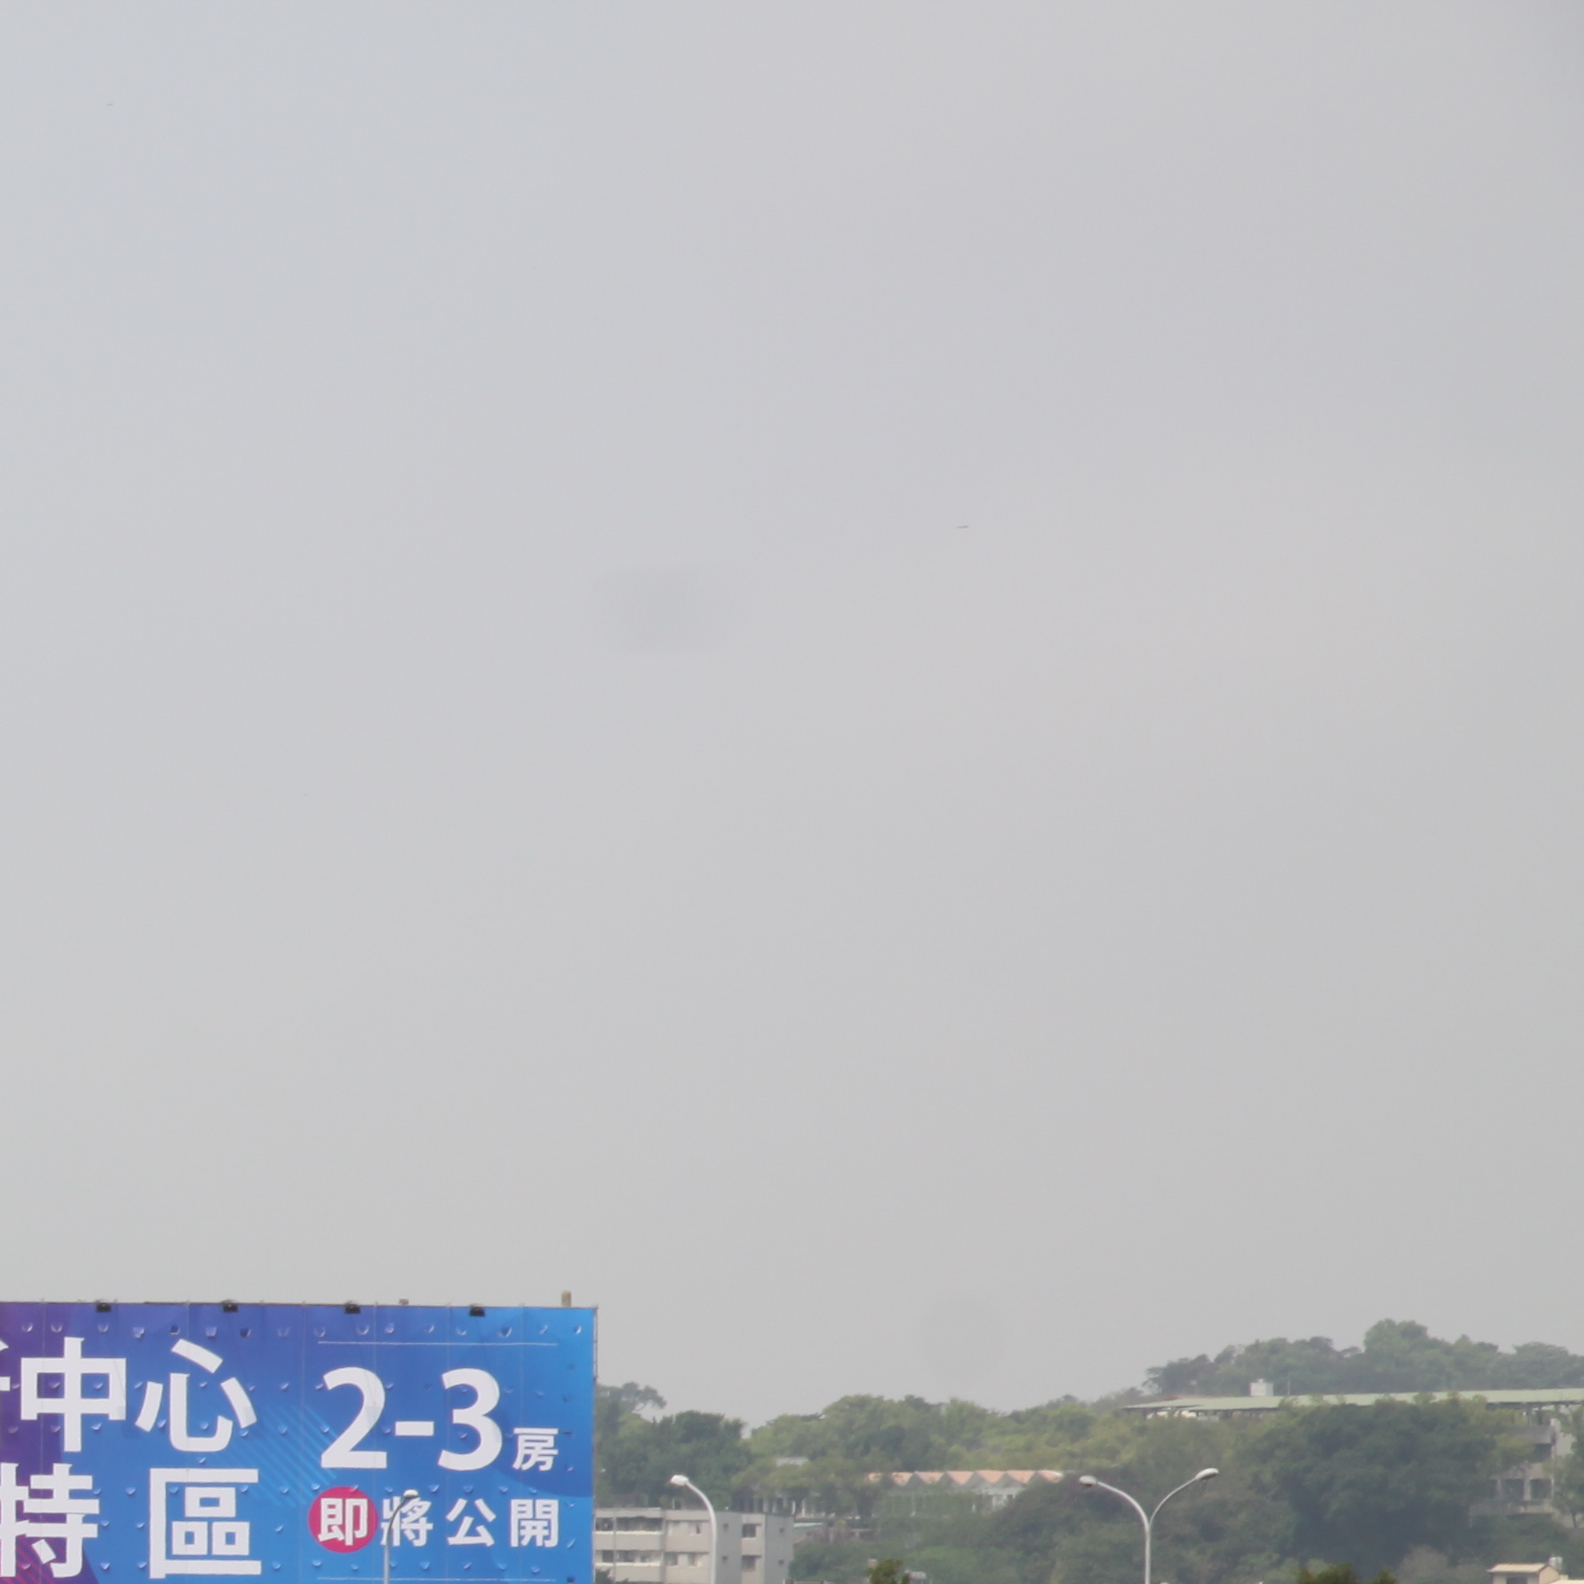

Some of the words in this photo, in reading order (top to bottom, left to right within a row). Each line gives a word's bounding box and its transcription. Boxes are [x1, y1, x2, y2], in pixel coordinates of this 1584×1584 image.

[321, 1367, 559, 1471] 2-3房
[318, 1496, 559, 1547] 即將公開
